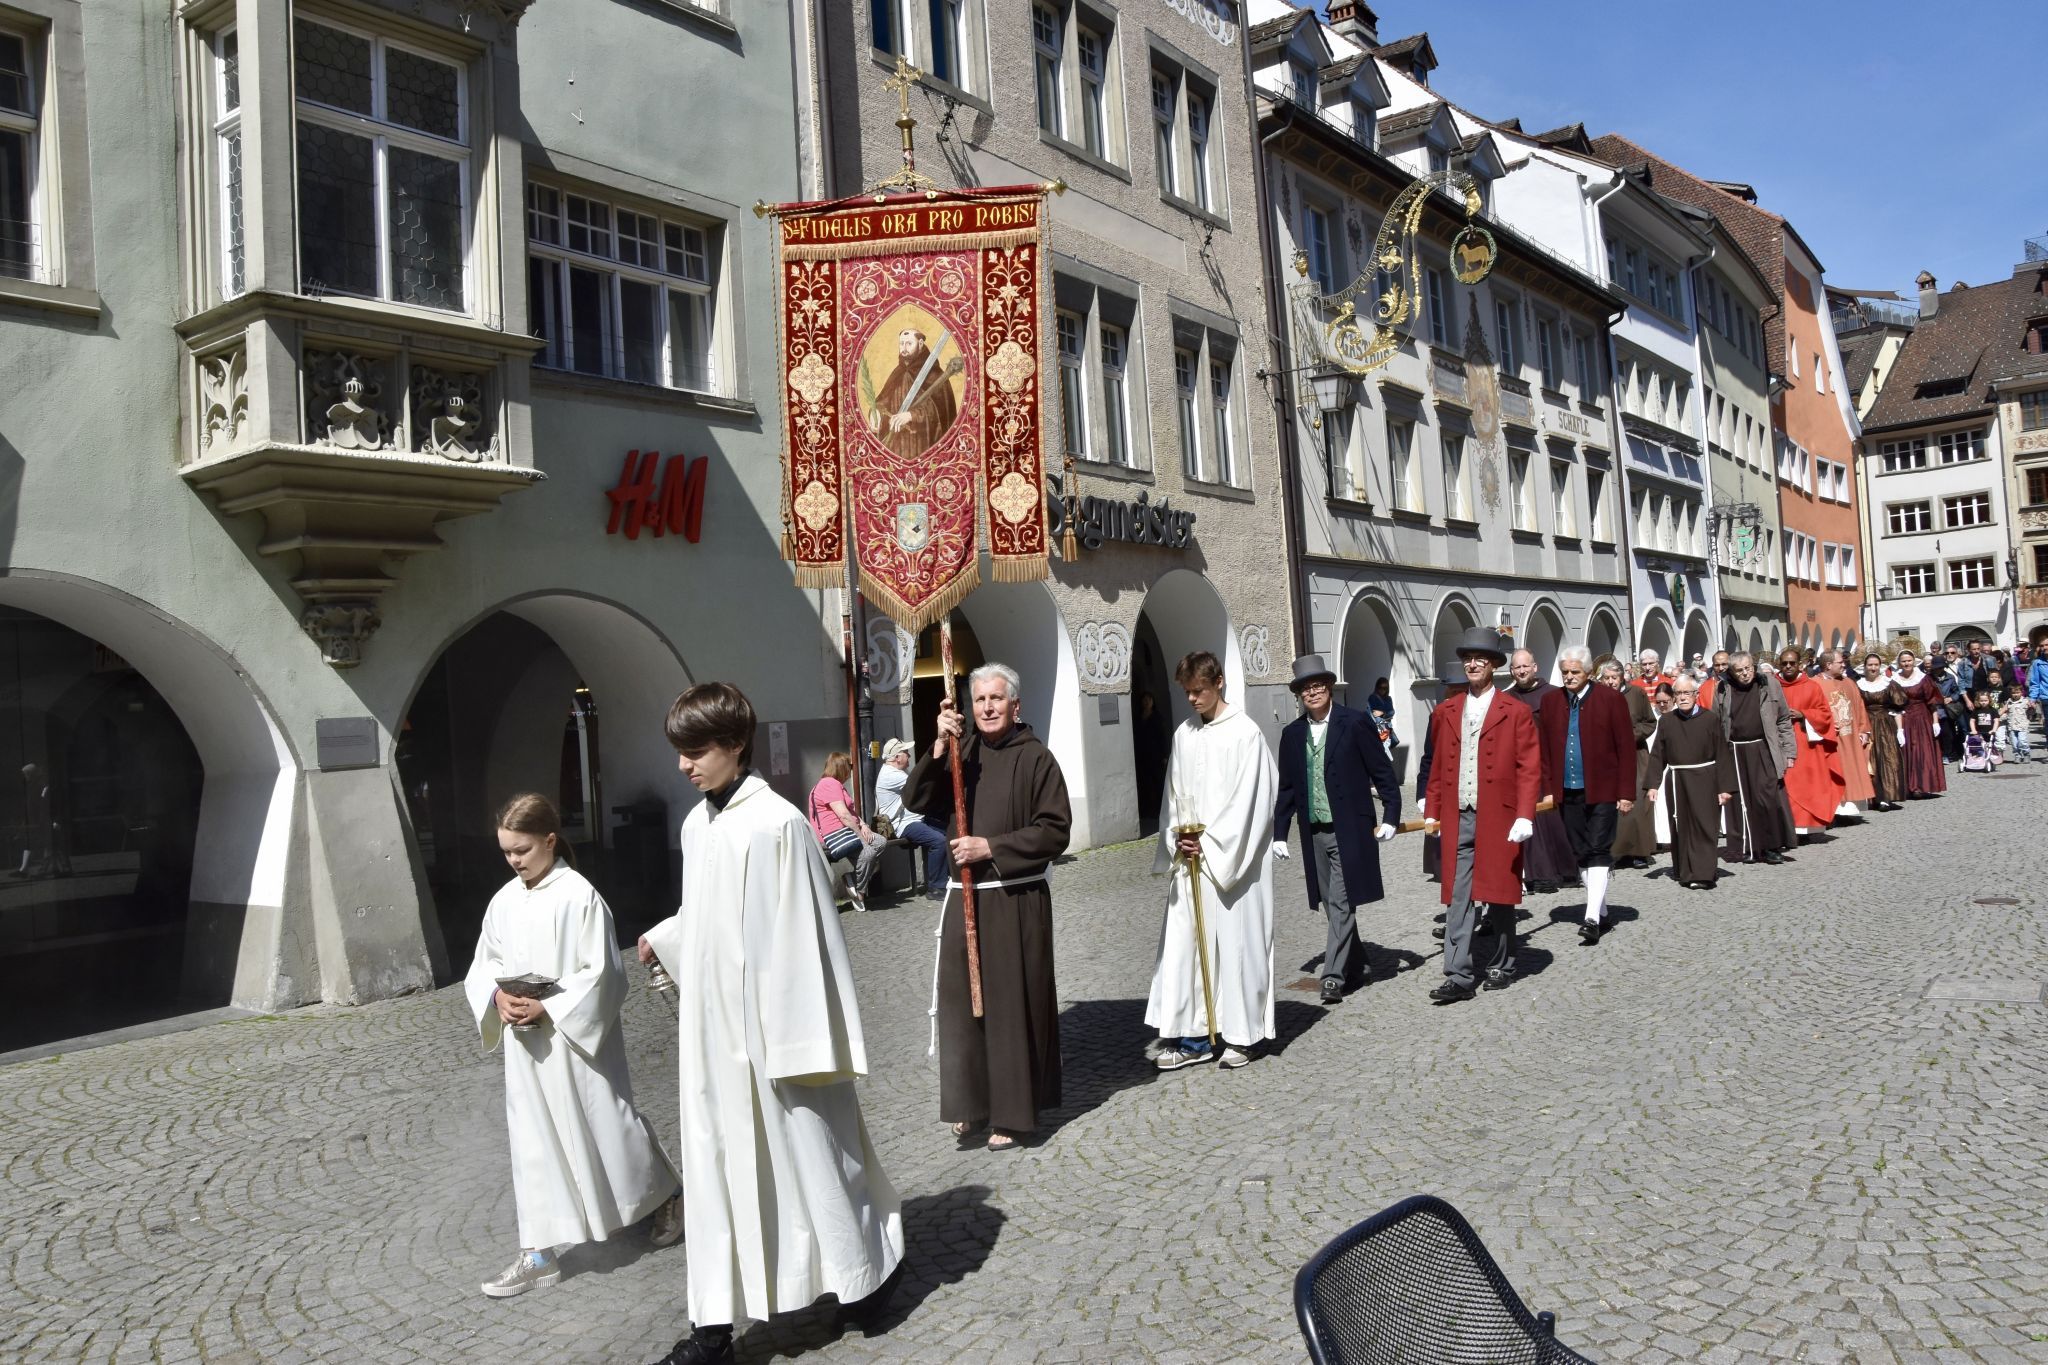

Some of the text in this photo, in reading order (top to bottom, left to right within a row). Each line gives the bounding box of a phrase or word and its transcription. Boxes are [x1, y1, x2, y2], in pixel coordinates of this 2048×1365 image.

[882, 212, 918, 234] ORA
[928, 209, 963, 231] PRO
[976, 202, 1034, 227] NOBIS!
[604, 449, 708, 544] H&M
[1737, 537, 1754, 559] P
[1500, 607, 1510, 625] dm
